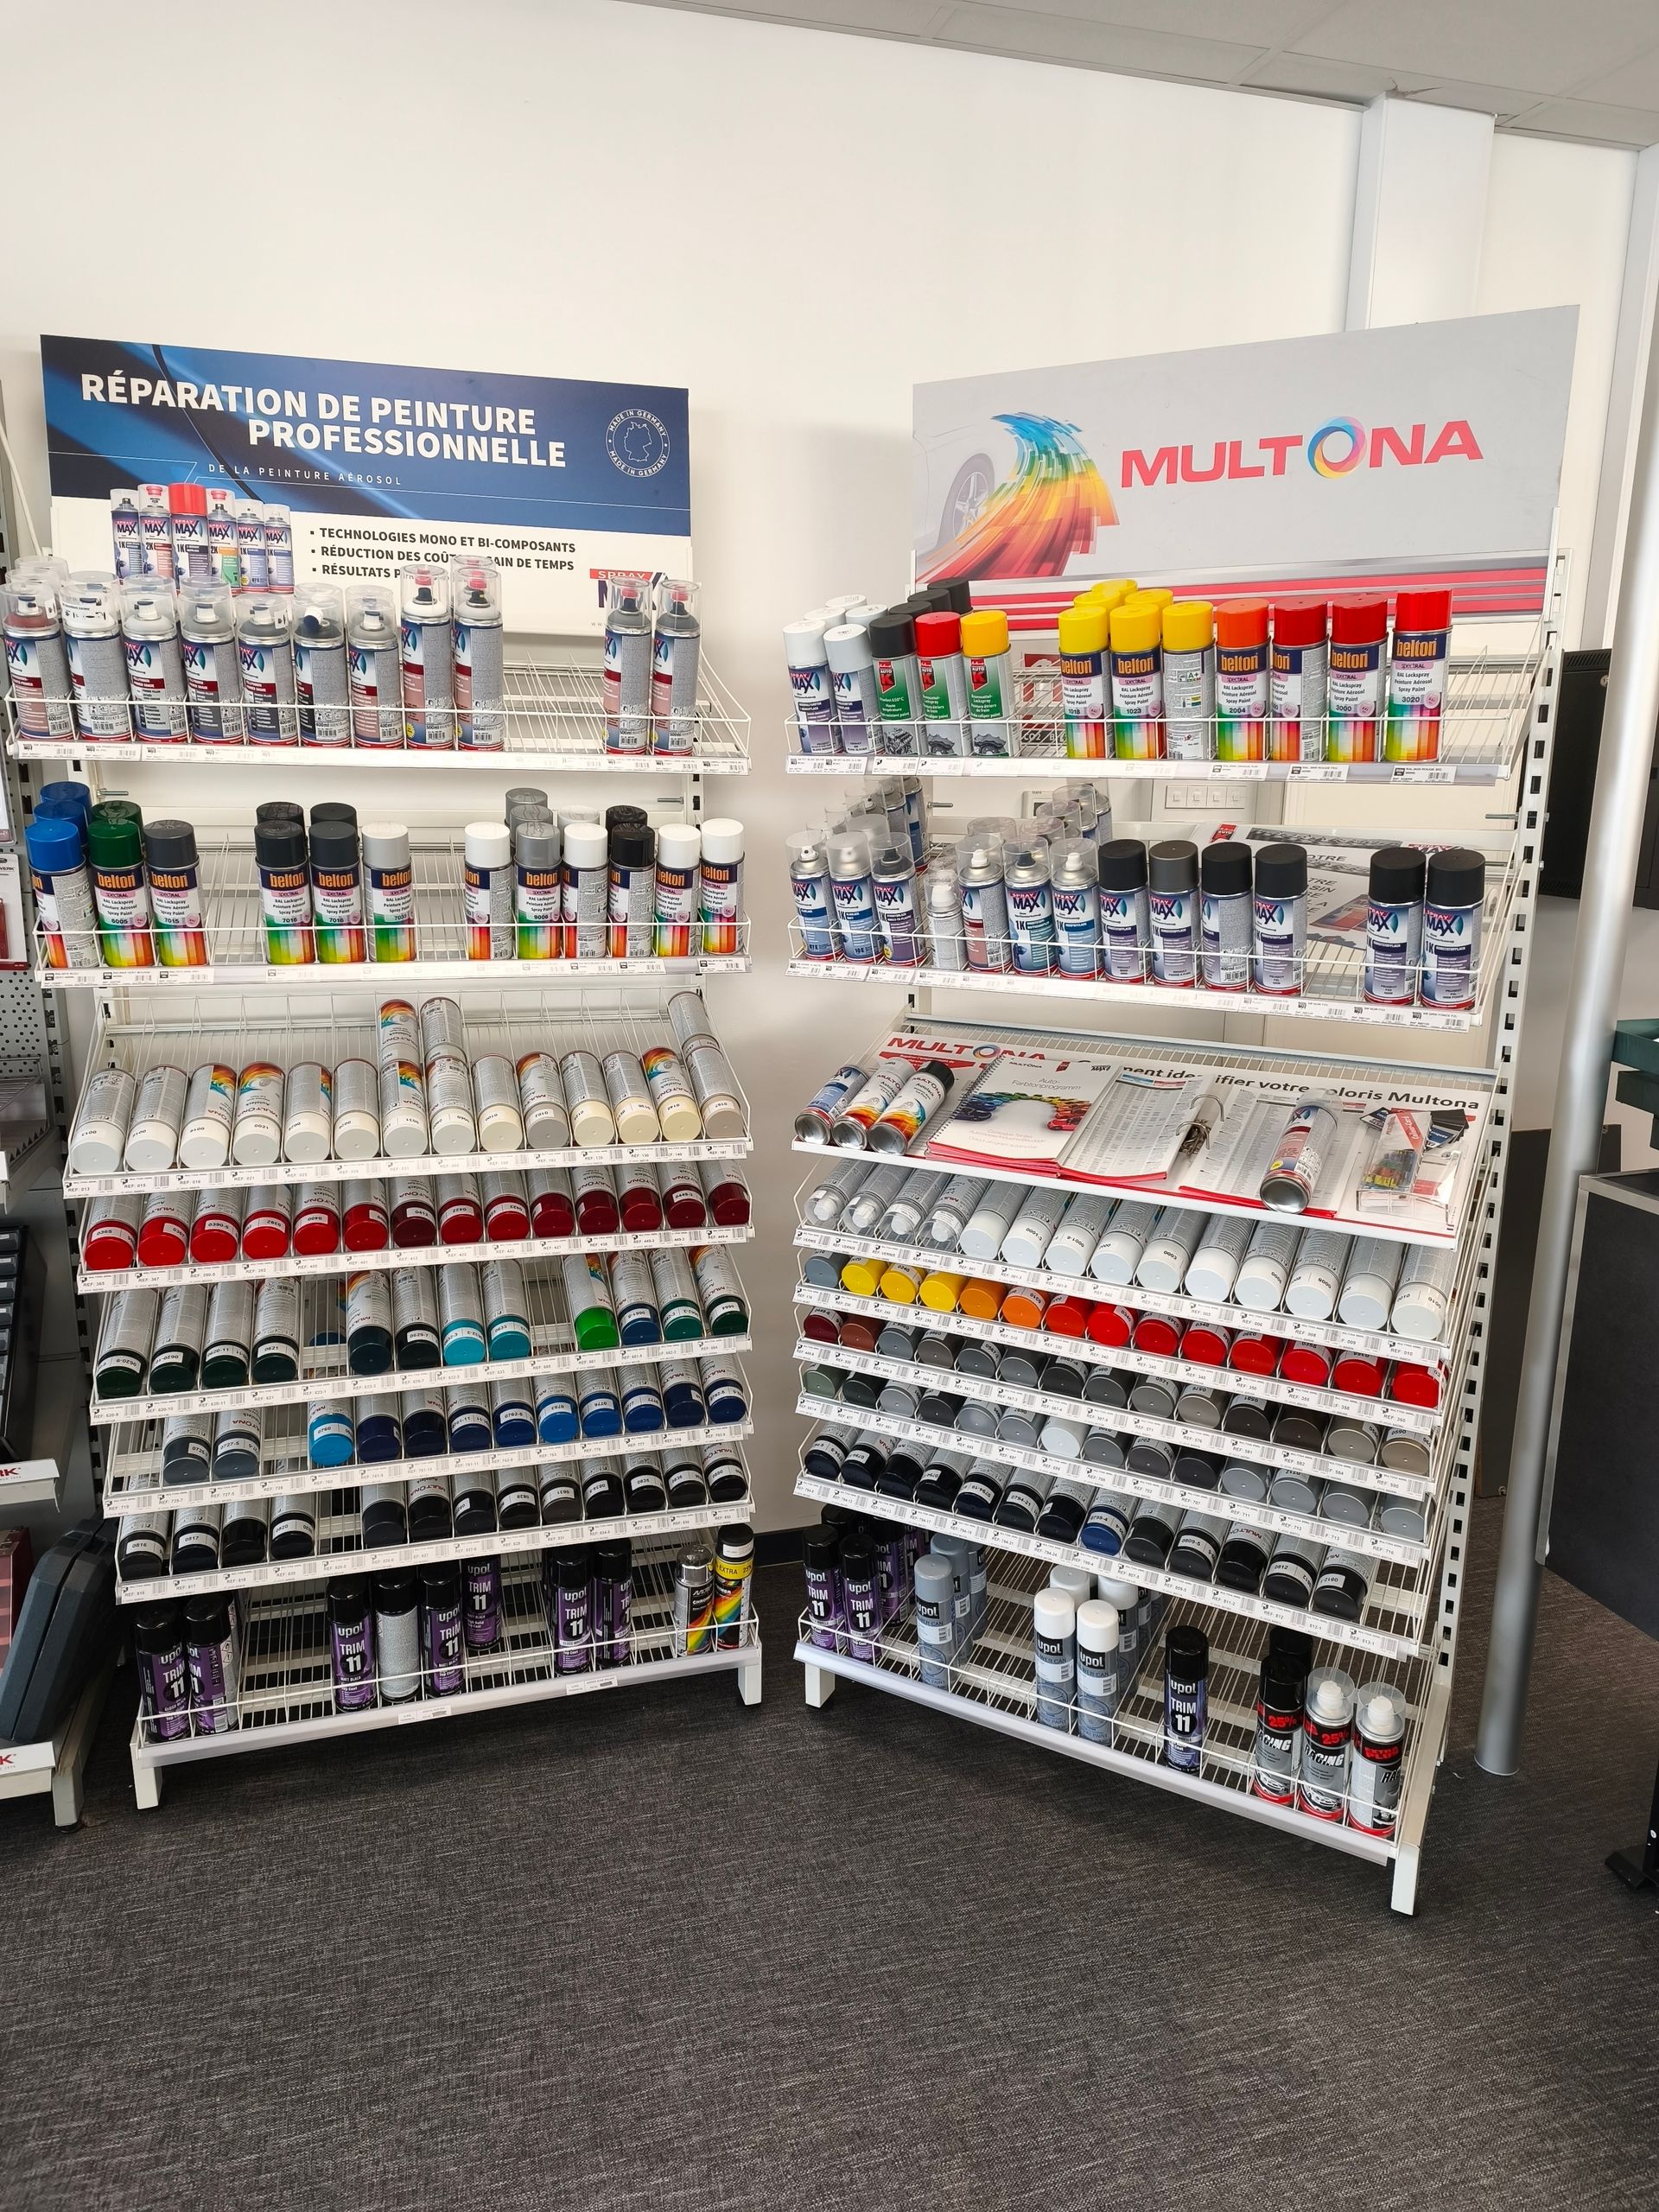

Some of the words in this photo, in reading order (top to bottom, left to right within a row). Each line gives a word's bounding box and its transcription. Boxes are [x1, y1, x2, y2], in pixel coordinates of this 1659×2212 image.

[81, 370, 307, 417] RÉPARATION
[317, 392, 360, 422] DE
[371, 397, 536, 435] PEINTURE
[609, 415, 625, 431] MADE
[637, 410, 666, 436] GERMANY
[248, 419, 566, 467] PROFESSIONNELLE
[1122, 415, 1484, 487] MULTONA
[610, 450, 626, 470] MADE
[639, 454, 667, 476] GERMANY
[208, 464, 225, 474] DE
[234, 466, 250, 475] LA
[258, 467, 330, 480] PEINTURE
[338, 473, 401, 485] AÉROSOL
[320, 527, 416, 543] TECHNOLOGIES
[419, 534, 457, 545] MONO
[461, 537, 474, 547] ET
[478, 537, 575, 553] BI-COMPOSANTS
[321, 544, 394, 560] RÉDUCTION
[397, 550, 421, 562] DES
[517, 558, 531, 569] DE
[535, 559, 575, 570] TEMPS
[322, 563, 391, 578] RÉSULTATS
[1396, 638, 1437, 657] belton
[1118, 655, 1154, 674] belton
[1221, 654, 1258, 671] belton
[1332, 650, 1369, 669] belton
[98, 873, 136, 889] belton
[152, 872, 188, 889] belton
[270, 872, 304, 887] belton
[319, 872, 353, 887] belton
[526, 871, 557, 887] belton
[835, 884, 858, 905] MAX
[876, 886, 899, 906] MAX
[1014, 891, 1043, 914] MAX
[1055, 893, 1081, 915] MAX
[1152, 898, 1179, 919] MAX
[1015, 919, 1026, 931] 1K
[1057, 920, 1065, 931] 1K
[1427, 912, 1458, 937] MAX
[1259, 1079, 1310, 1093] votre
[1326, 1087, 1382, 1101] oloris
[1388, 1090, 1480, 1111] Multona
[467, 1562, 491, 1577] upol
[719, 1566, 738, 1575] EXTRA
[806, 1569, 827, 1584] upol
[468, 1580, 492, 1592] TRIM
[564, 1586, 587, 1603] upol
[808, 1585, 829, 1601] TRIM
[849, 1581, 872, 1595] upol
[473, 1594, 486, 1611] 11
[812, 1599, 824, 1618] 11
[850, 1599, 874, 1612] TRIM
[917, 1603, 938, 1618] upol
[438, 1604, 460, 1622] upol
[565, 1604, 588, 1620] TRIM
[856, 1612, 871, 1629] 11
[338, 1622, 364, 1639] upol
[440, 1622, 461, 1641] TRIM
[569, 1619, 583, 1637] 11
[160, 1645, 182, 1666] upol
[340, 1640, 365, 1656] TRIM
[446, 1637, 459, 1657] 11
[1038, 1640, 1062, 1655] upol
[346, 1655, 361, 1673] 11
[1080, 1652, 1104, 1669] upol
[162, 1664, 185, 1683] TRIM
[170, 1681, 186, 1699] 11
[1171, 1680, 1197, 1699] upol
[1171, 1697, 1197, 1715] TRIM
[1175, 1714, 1191, 1732] 11
[1268, 1715, 1296, 1727] 25%
[1322, 1732, 1349, 1745] 25%
[1305, 1742, 1344, 1767] RACING
